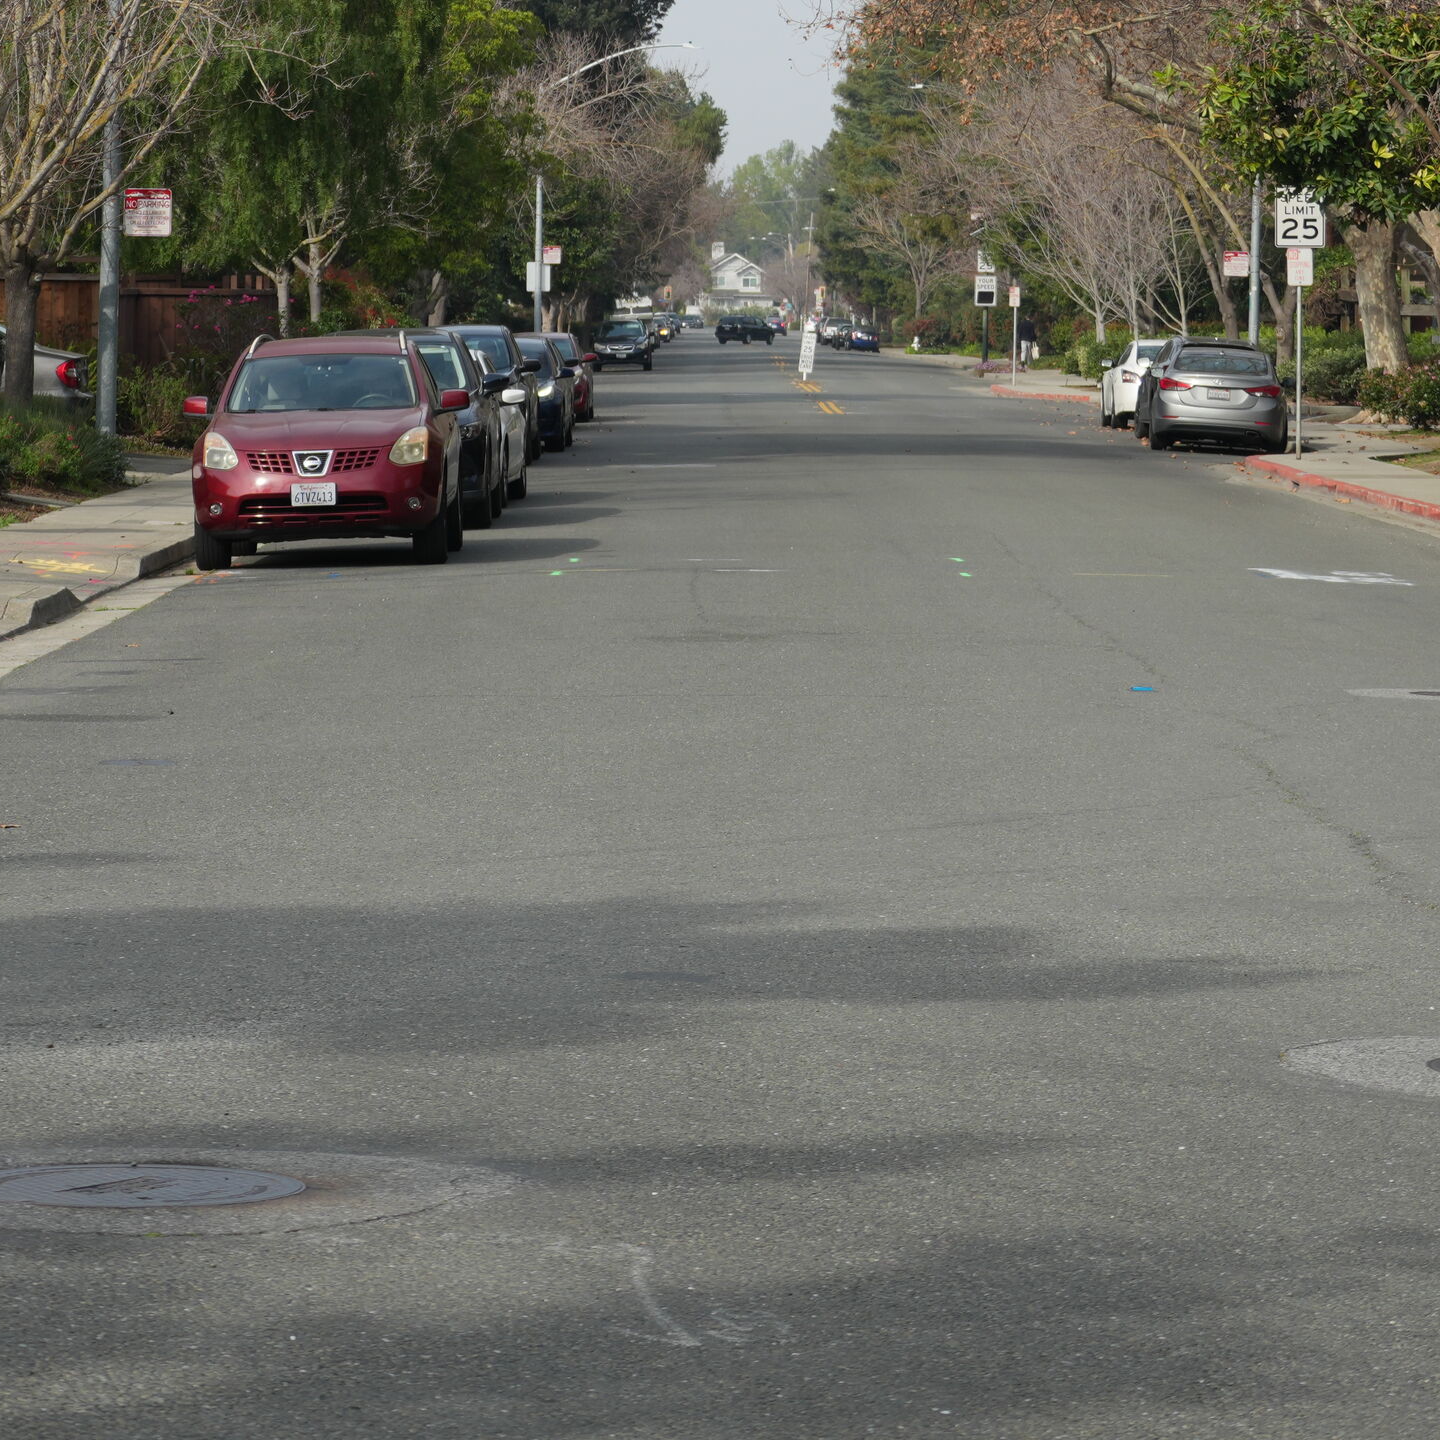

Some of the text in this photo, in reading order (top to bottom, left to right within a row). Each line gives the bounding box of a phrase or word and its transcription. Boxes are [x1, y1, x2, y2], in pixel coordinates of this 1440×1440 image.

[1280, 193, 1317, 202] SPEE
[126, 200, 170, 208] NO PARKING
[1284, 206, 1315, 215] LIMIT
[1282, 218, 1318, 239] 25
[803, 345, 813, 353] 25
[294, 491, 333, 503] 6TVZ413
